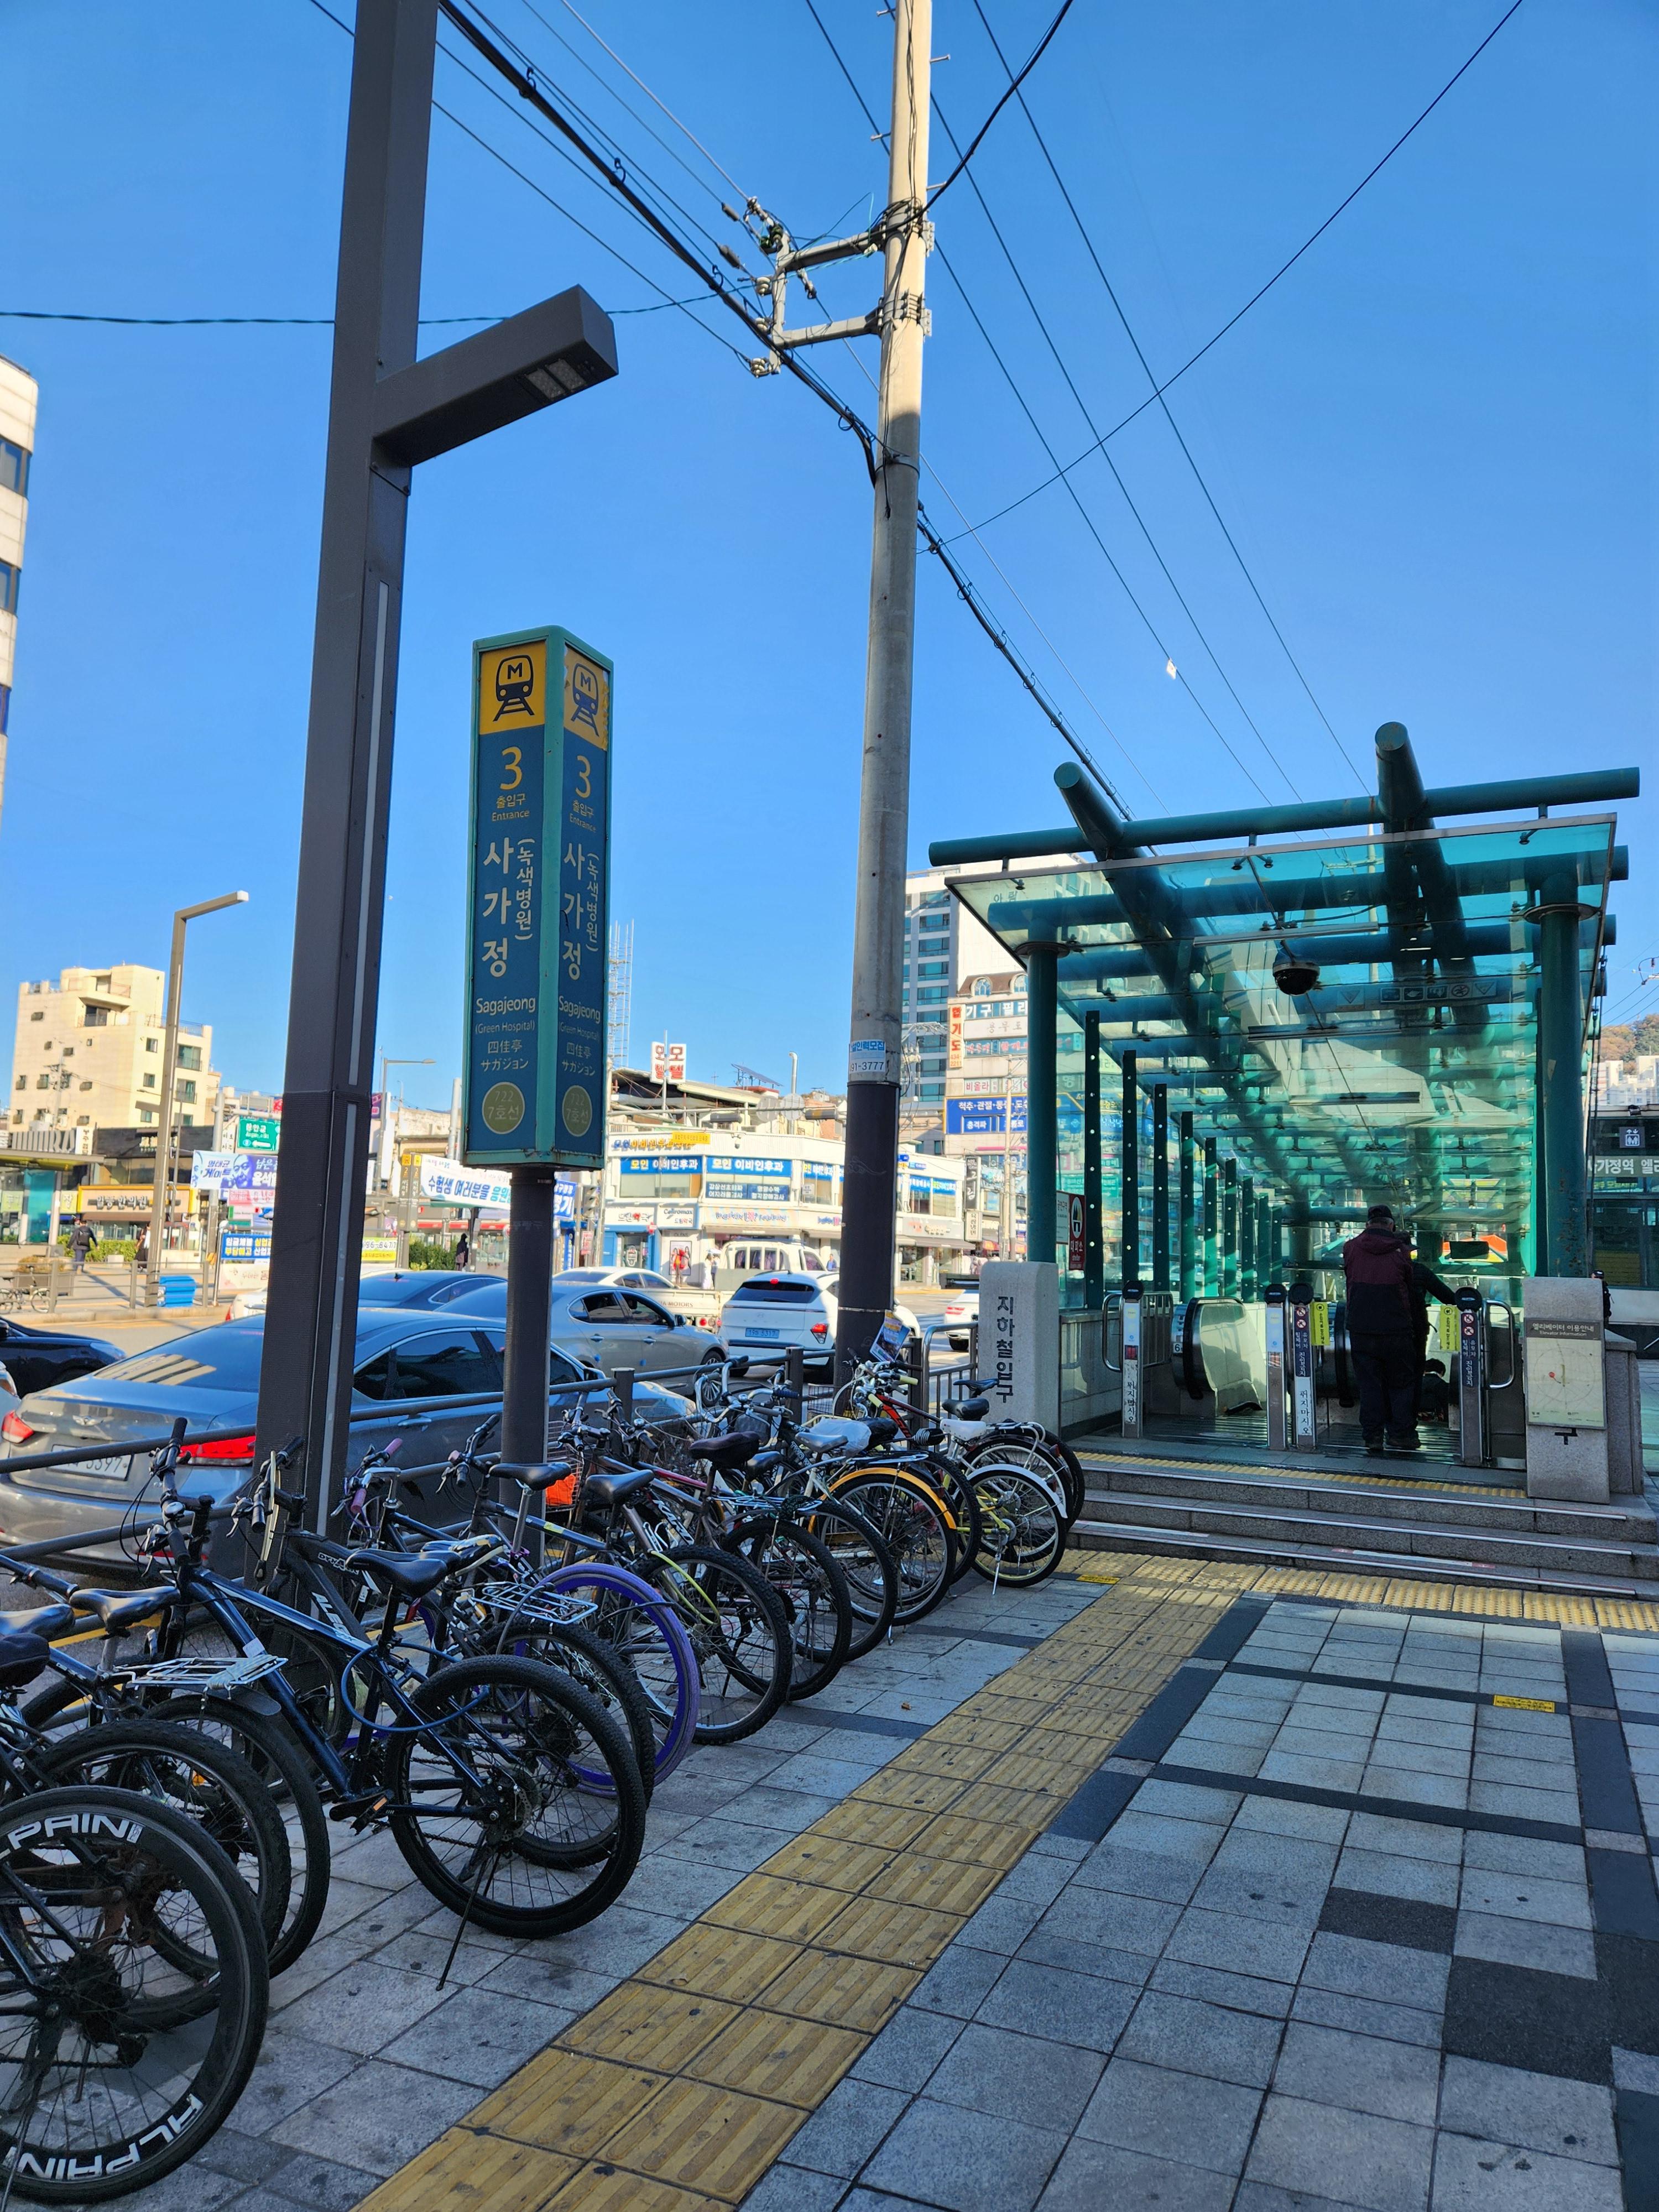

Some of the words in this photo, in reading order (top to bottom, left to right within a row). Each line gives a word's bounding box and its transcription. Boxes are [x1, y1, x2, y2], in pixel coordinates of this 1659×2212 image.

[500, 747, 522, 790] 3
[575, 755, 591, 798] 3
[496, 793, 526, 808] 출입구
[572, 800, 594, 816] 출입구
[492, 810, 529, 822] Entrance
[569, 814, 597, 832] Entrance
[515, 838, 535, 940] (녹색병원)
[482, 837, 514, 977] 사가정
[586, 853, 599, 952] (녹색병원)
[563, 843, 585, 980] 사가정
[476, 996, 536, 1016] Sagajeong
[559, 995, 601, 1024] Sagajeong
[966, 1004, 992, 1019] 기구
[475, 1022, 500, 1034] (Green
[502, 1021, 535, 1033] Hospital)
[559, 1022, 576, 1035] (Green
[577, 1026, 599, 1041] Hospital)
[488, 1039, 523, 1053] 四佳亭
[566, 1042, 592, 1059] 四佳亭
[852, 1041, 885, 1052] 설인력모집
[481, 1059, 528, 1072] サガジョン
[669, 1046, 685, 1080] 모텔
[850, 1061, 884, 1072] 91-3777
[966, 1081, 989, 1092] 비올라
[495, 1091, 513, 1102] 722
[488, 1107, 519, 1120] 7호선
[203, 1168, 232, 1178] 게이트
[734, 1159, 784, 1172] 이비인후과
[428, 1175, 454, 1195] 수험생
[454, 1180, 491, 1201] 여러분을
[1071, 1240, 1083, 1253] 대피소
[1532, 1322, 1565, 1331] 엘리베이터
[1567, 1324, 1594, 1332] 이용안내
[996, 1296, 1015, 1404] 지하철입구
